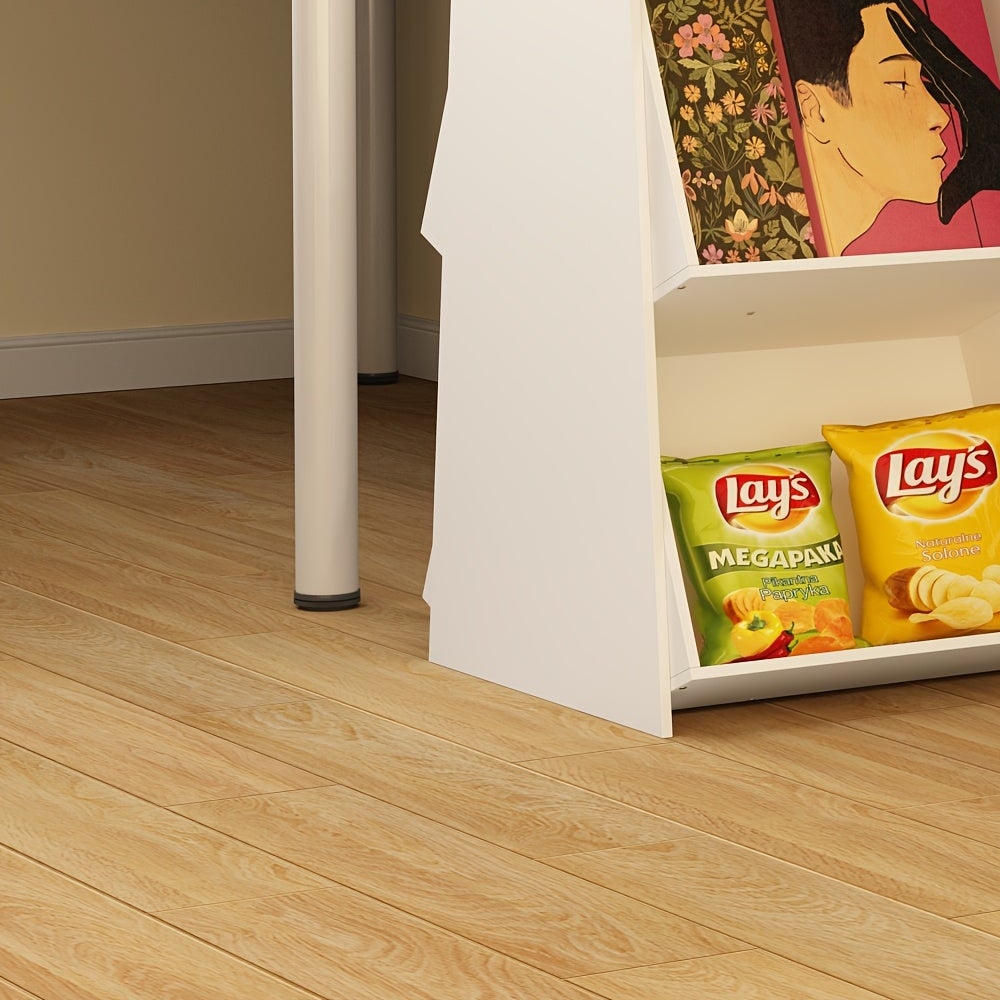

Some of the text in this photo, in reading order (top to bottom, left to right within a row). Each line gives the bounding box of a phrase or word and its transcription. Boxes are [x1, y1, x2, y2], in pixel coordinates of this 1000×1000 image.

[886, 446, 989, 504] Lay's
[726, 475, 809, 520] Lay's
[915, 532, 982, 549] Naturalne
[921, 546, 981, 562] Solone
[761, 574, 819, 588] Pikantna
[759, 584, 831, 602] Papryka
